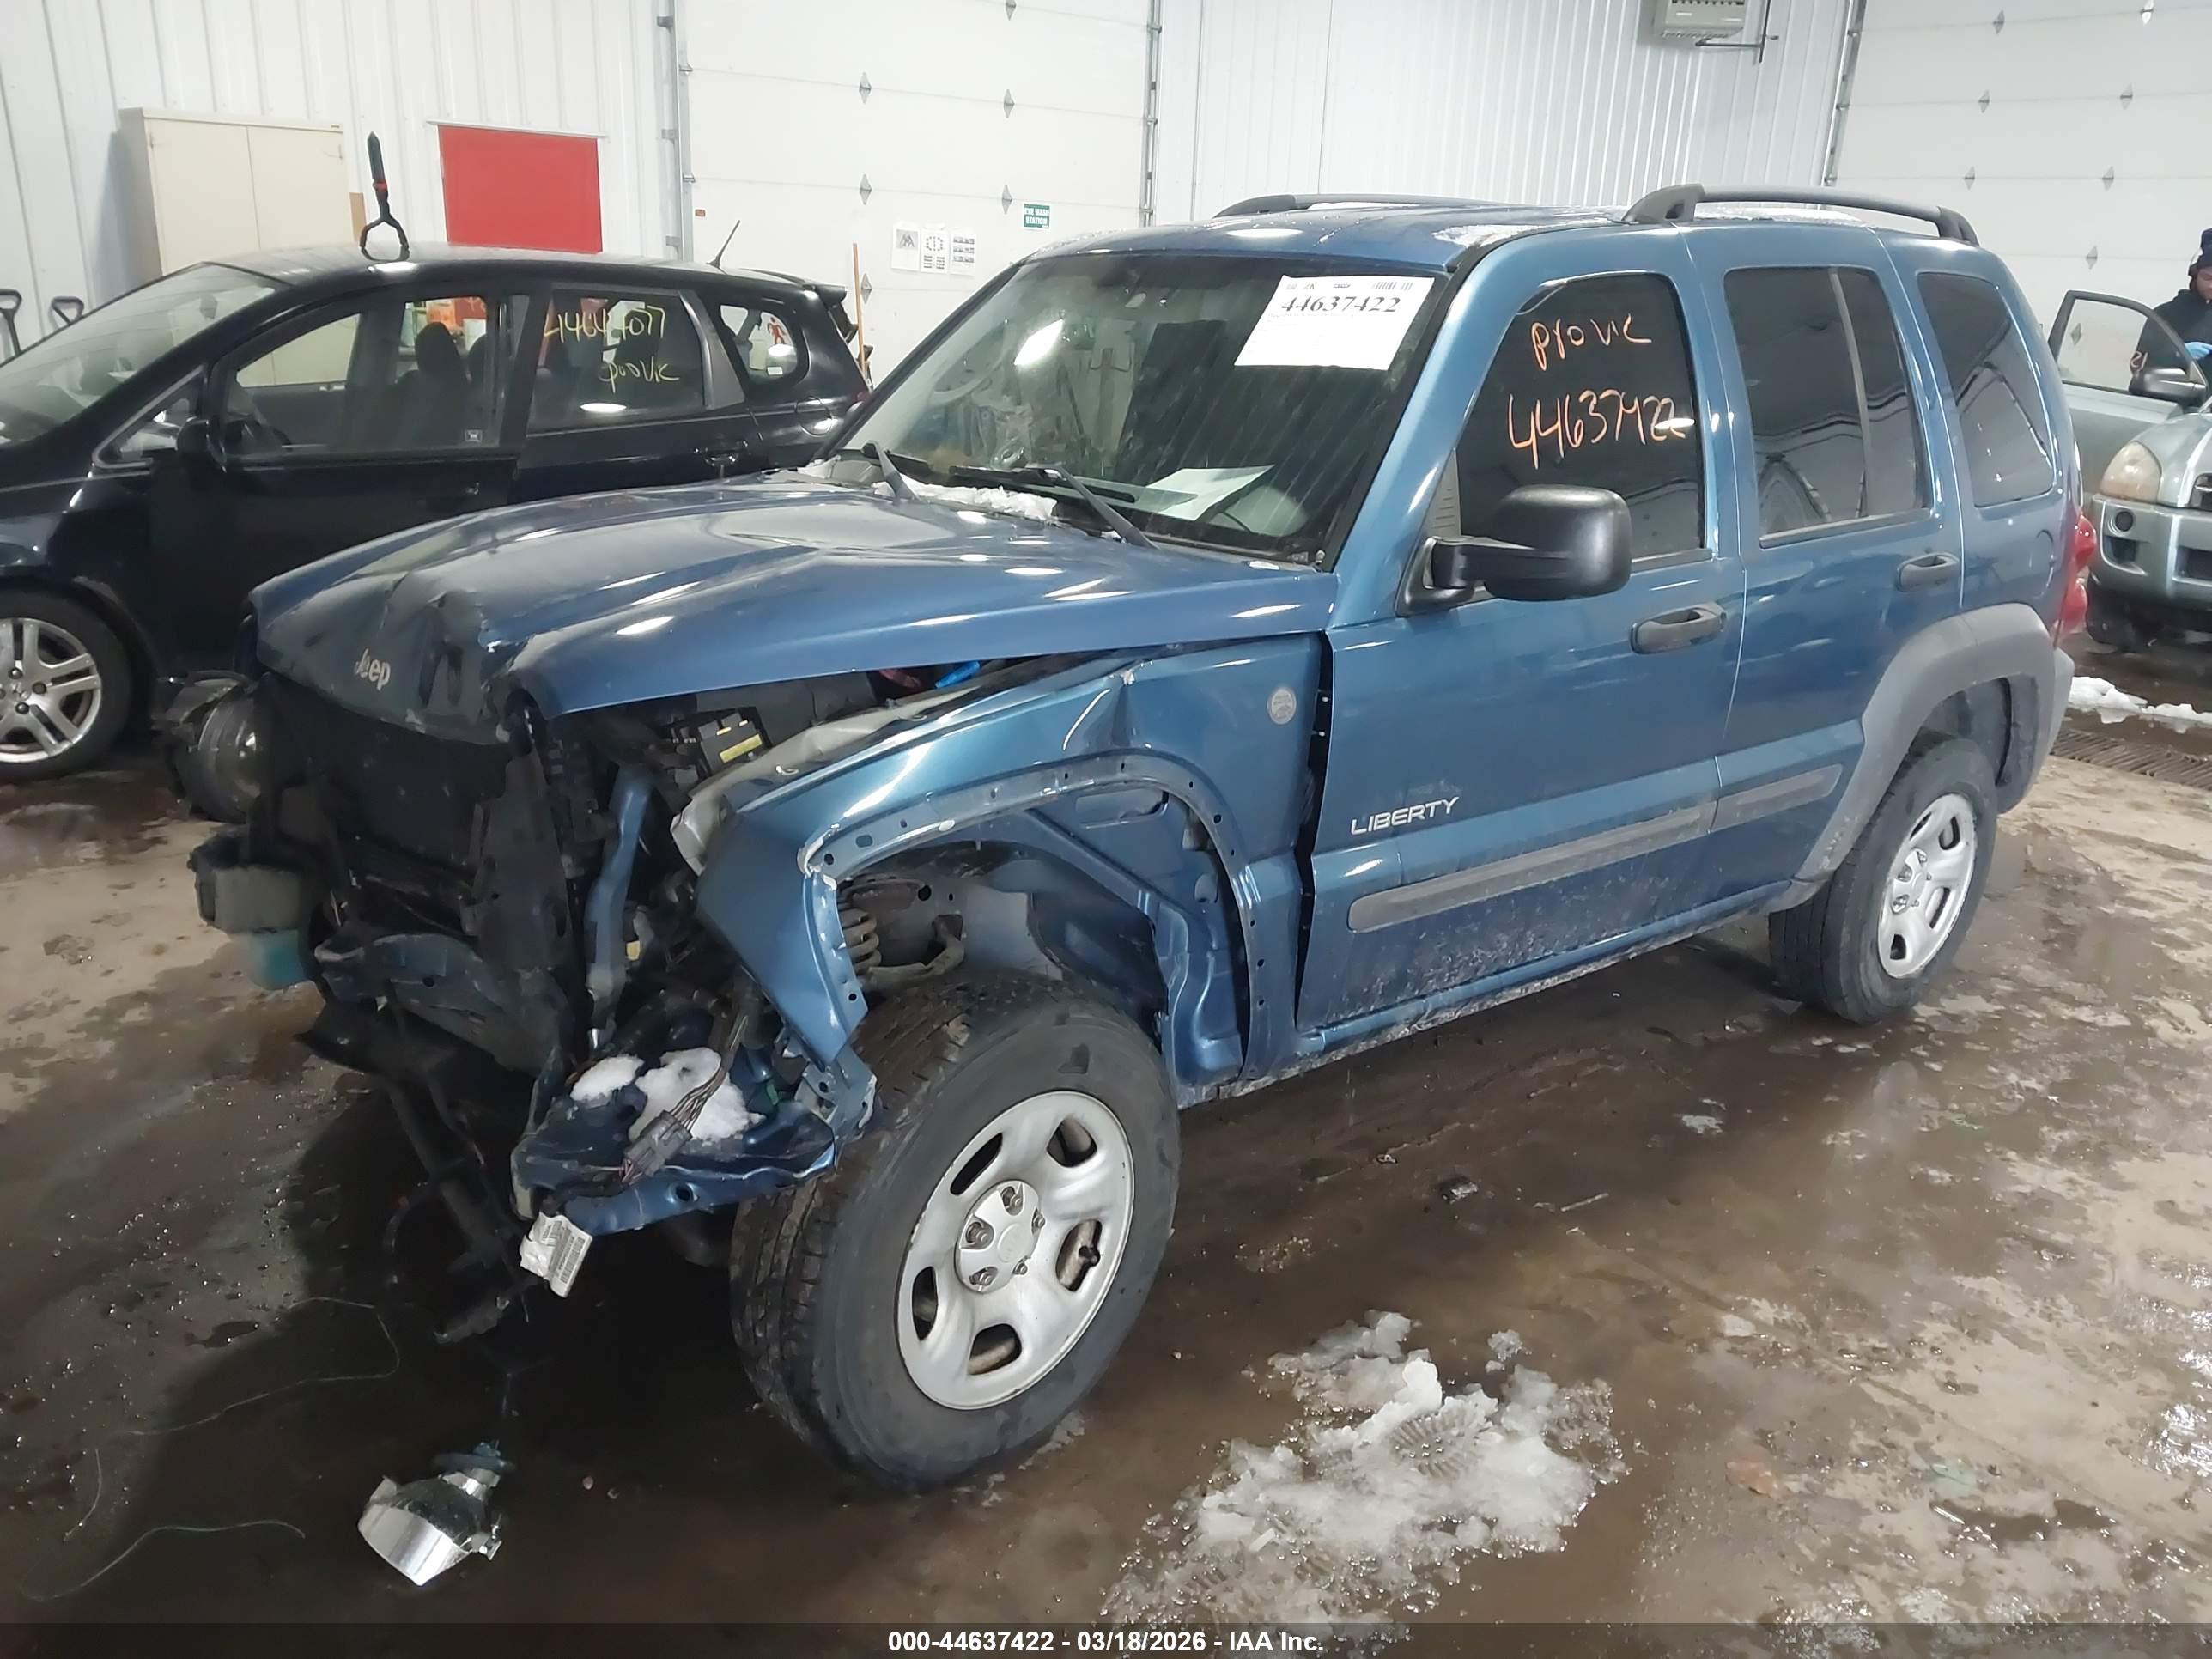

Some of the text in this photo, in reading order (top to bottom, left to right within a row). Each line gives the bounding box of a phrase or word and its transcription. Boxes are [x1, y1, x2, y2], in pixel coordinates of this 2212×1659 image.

[1281, 295, 1401, 313] 44637422
[354, 647, 392, 691] Jeep
[1351, 796, 1460, 836] LIBERTY
